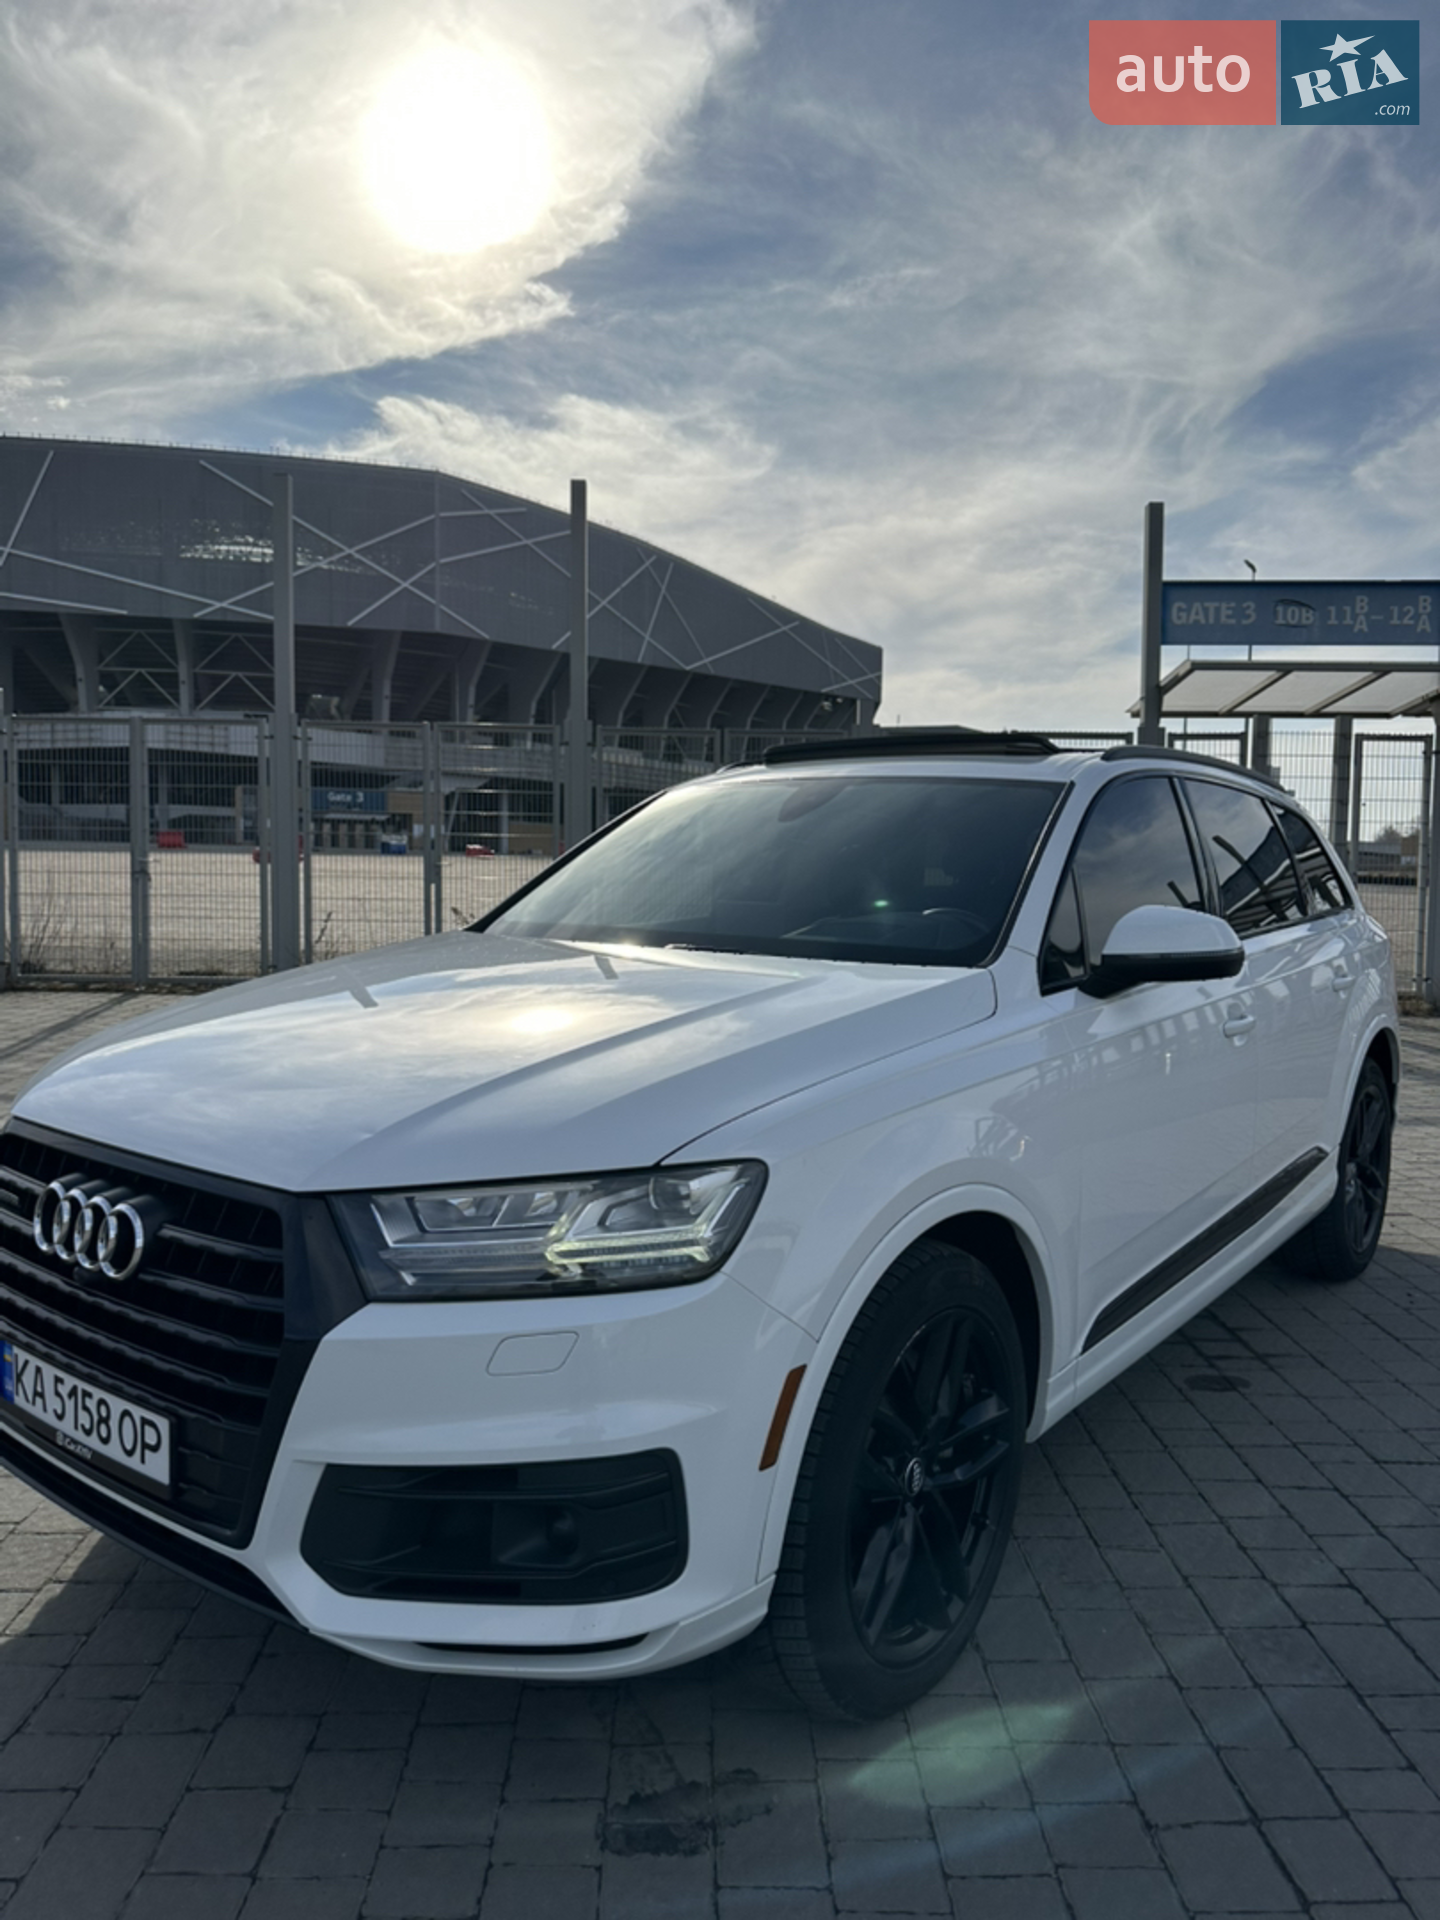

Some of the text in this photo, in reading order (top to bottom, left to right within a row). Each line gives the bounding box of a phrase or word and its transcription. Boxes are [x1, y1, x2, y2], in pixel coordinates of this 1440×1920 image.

[1171, 602, 1236, 625] GATE
[1241, 602, 1257, 625] 3
[1274, 606, 1315, 625] 10B
[327, 791, 364, 802] Gate 3
[13, 1352, 48, 1414] KA
[52, 1373, 112, 1446] 5158
[117, 1408, 162, 1466] OP
